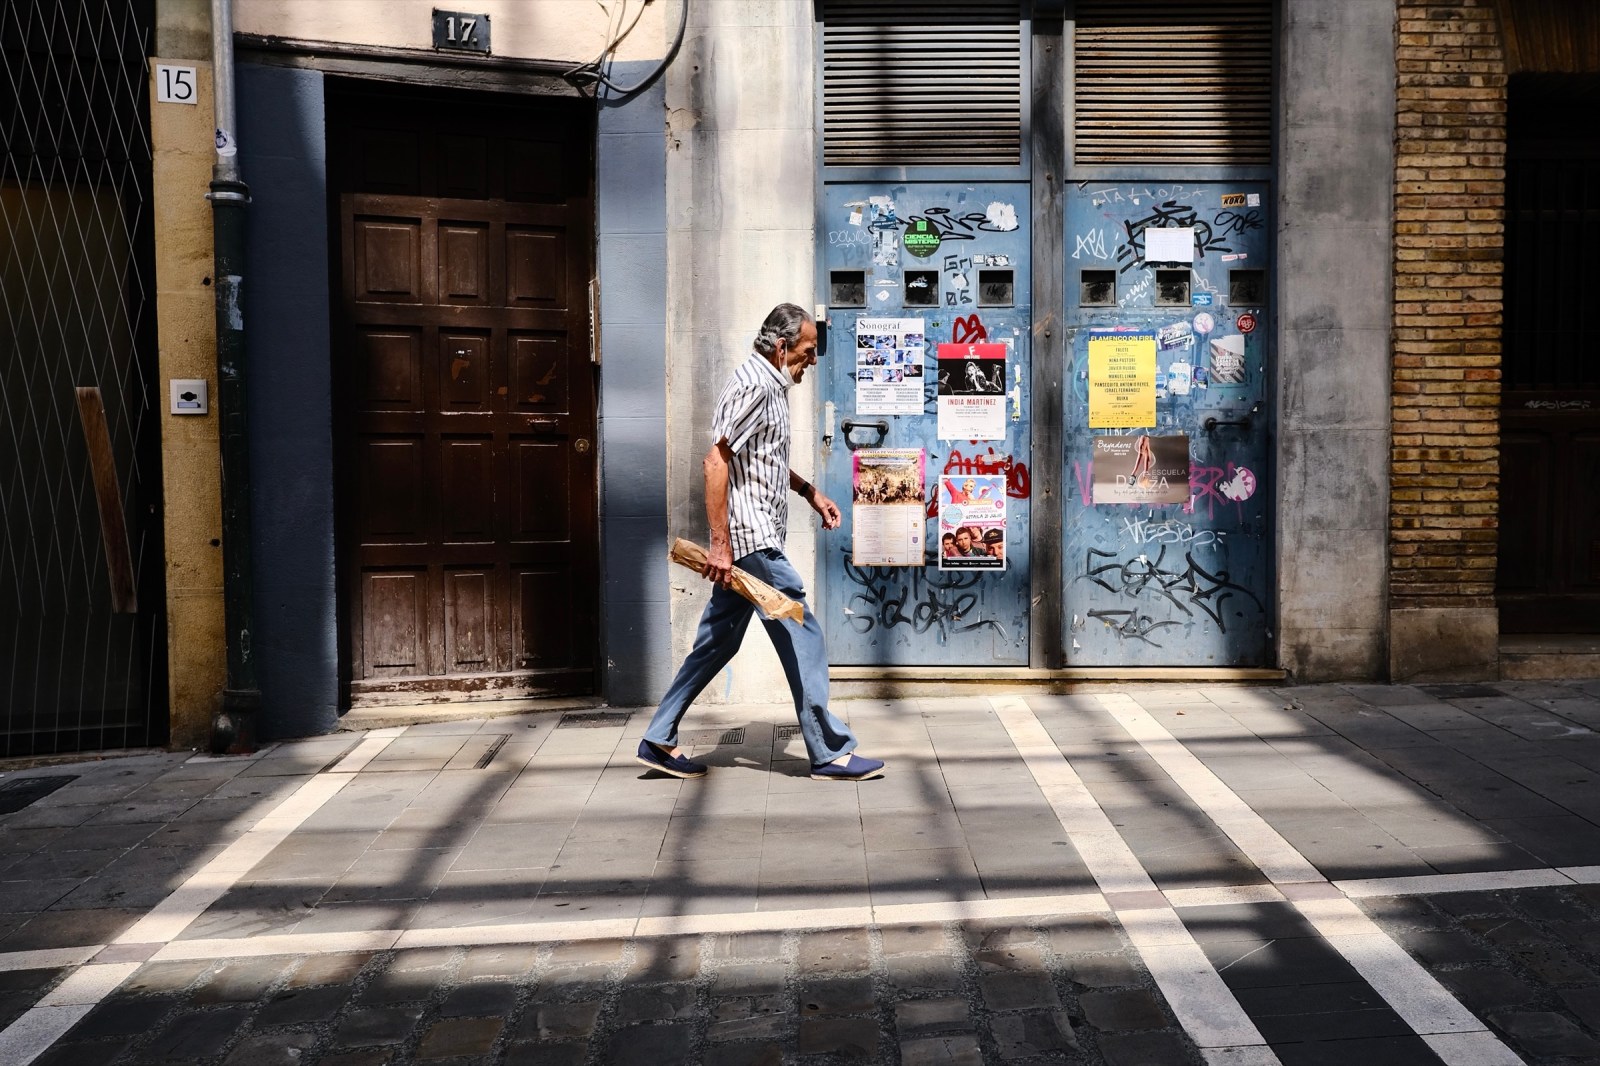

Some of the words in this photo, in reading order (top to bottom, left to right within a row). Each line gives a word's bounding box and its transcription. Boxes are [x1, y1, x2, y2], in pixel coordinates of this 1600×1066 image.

[162, 69, 192, 100] 15
[859, 320, 901, 331] Sonograf
[947, 398, 965, 406] INDIA
[966, 397, 997, 406] MARTÍNEZ
